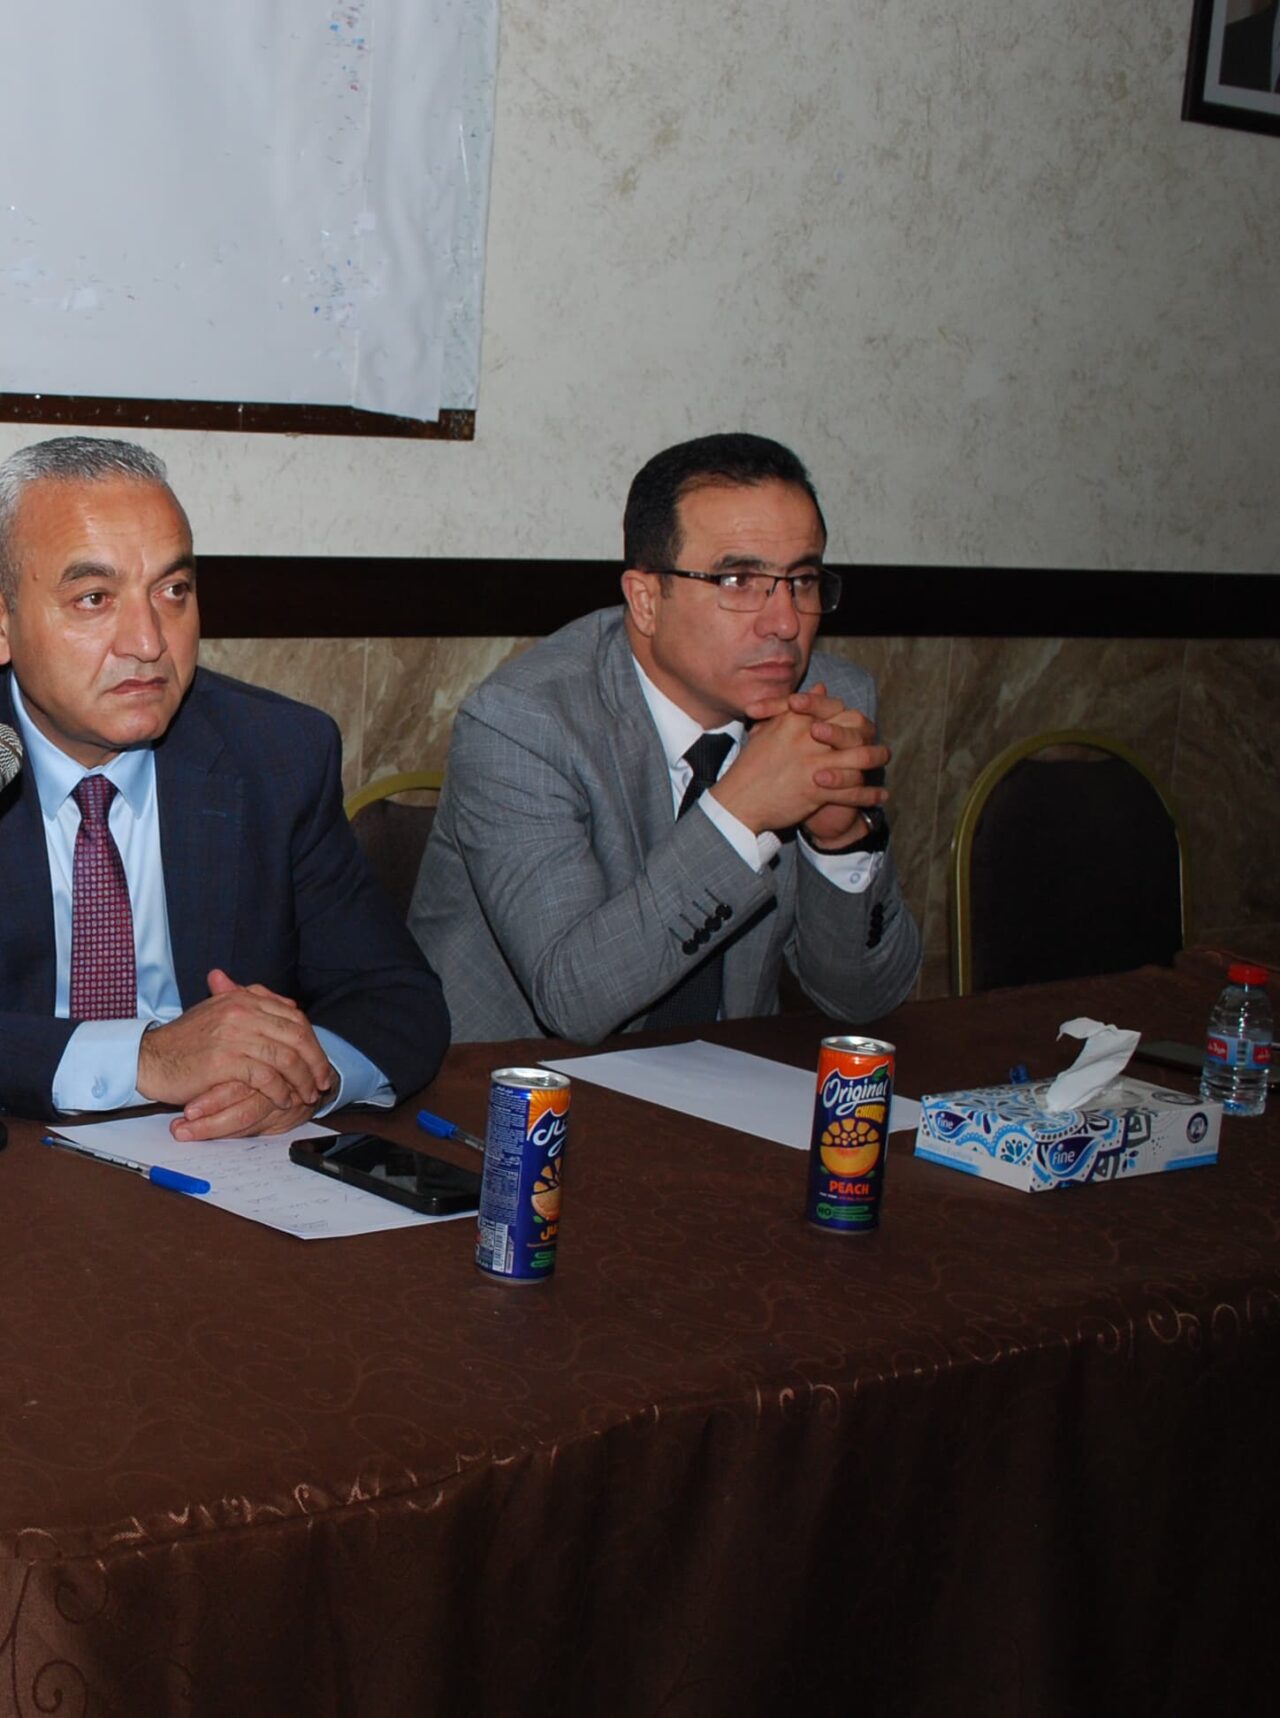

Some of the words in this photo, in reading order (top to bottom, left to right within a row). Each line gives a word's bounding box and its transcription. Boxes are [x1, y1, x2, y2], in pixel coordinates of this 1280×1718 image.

[823, 1079, 889, 1115] Original
[937, 1113, 954, 1129] fine
[1052, 1143, 1076, 1165] fine
[829, 1180, 869, 1194] PEACH
